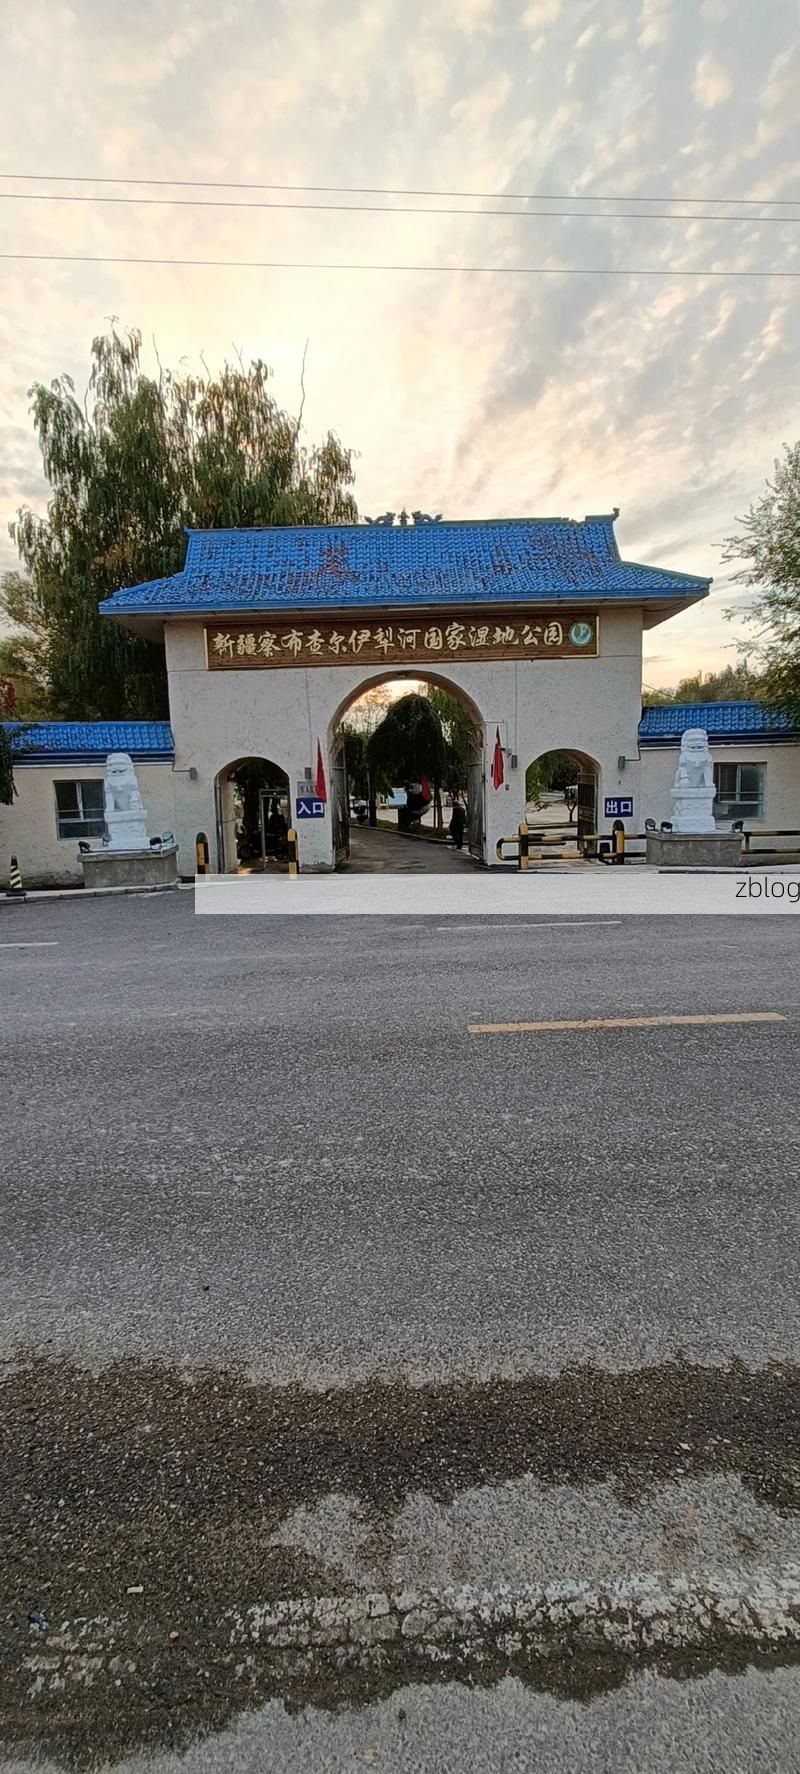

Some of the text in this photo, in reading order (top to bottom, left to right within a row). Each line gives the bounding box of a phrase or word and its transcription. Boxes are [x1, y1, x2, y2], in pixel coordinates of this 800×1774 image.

[212, 621, 564, 659] 新疆察布查尔伊犁河国家湿地公园
[297, 801, 324, 815] 入口
[606, 800, 632, 814] 出口
